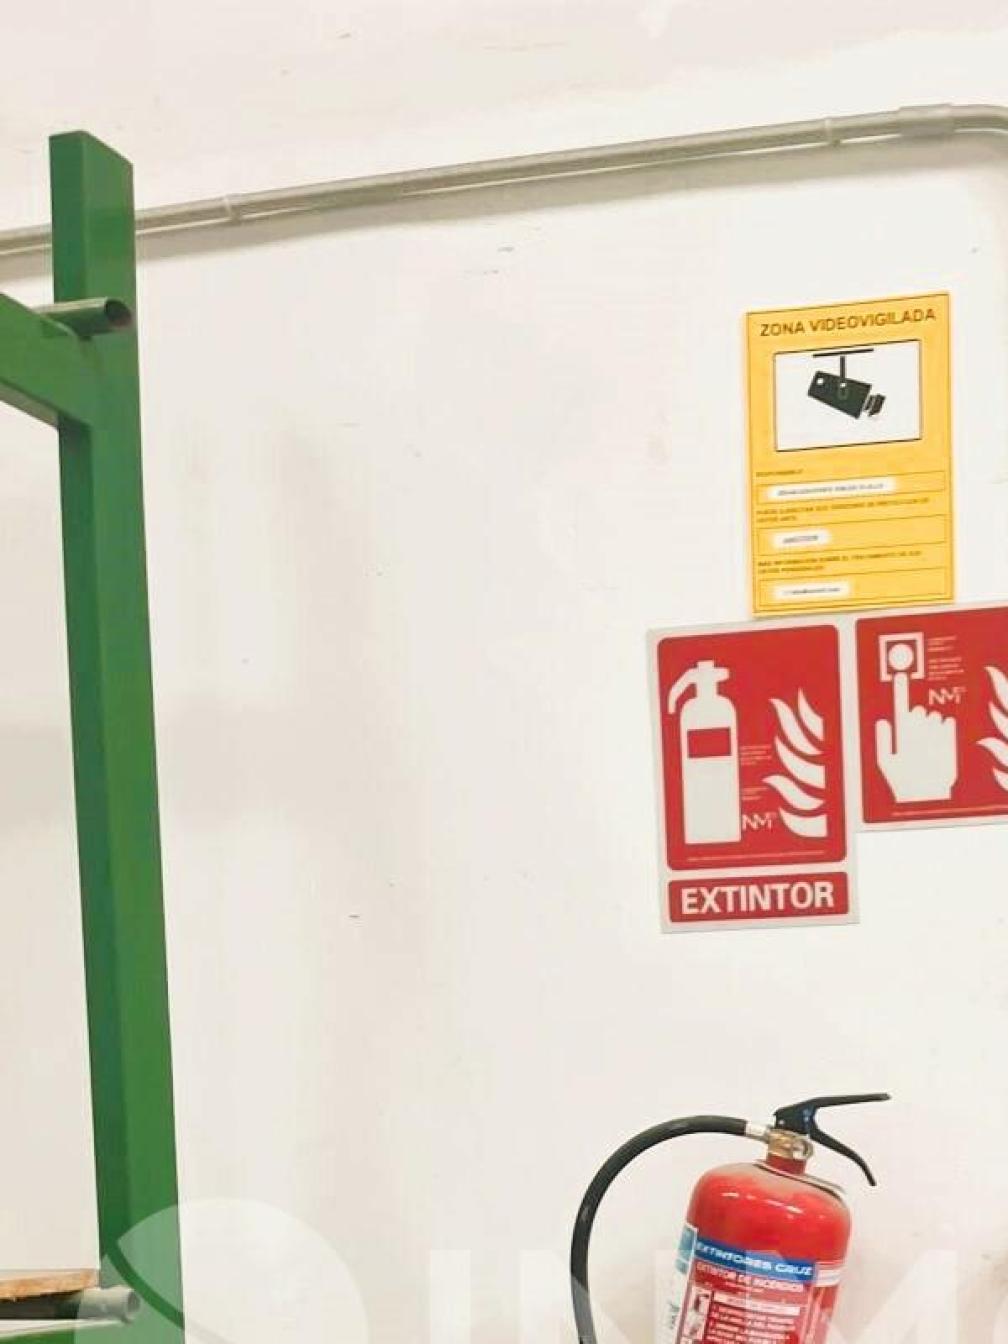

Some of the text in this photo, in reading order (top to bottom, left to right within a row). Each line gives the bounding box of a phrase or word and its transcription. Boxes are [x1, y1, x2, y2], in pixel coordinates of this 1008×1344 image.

[760, 308, 937, 337] ZONA VIDEOVIGILADA
[680, 881, 834, 915] EXTINTOR
[775, 1262, 813, 1276] CRUZ
